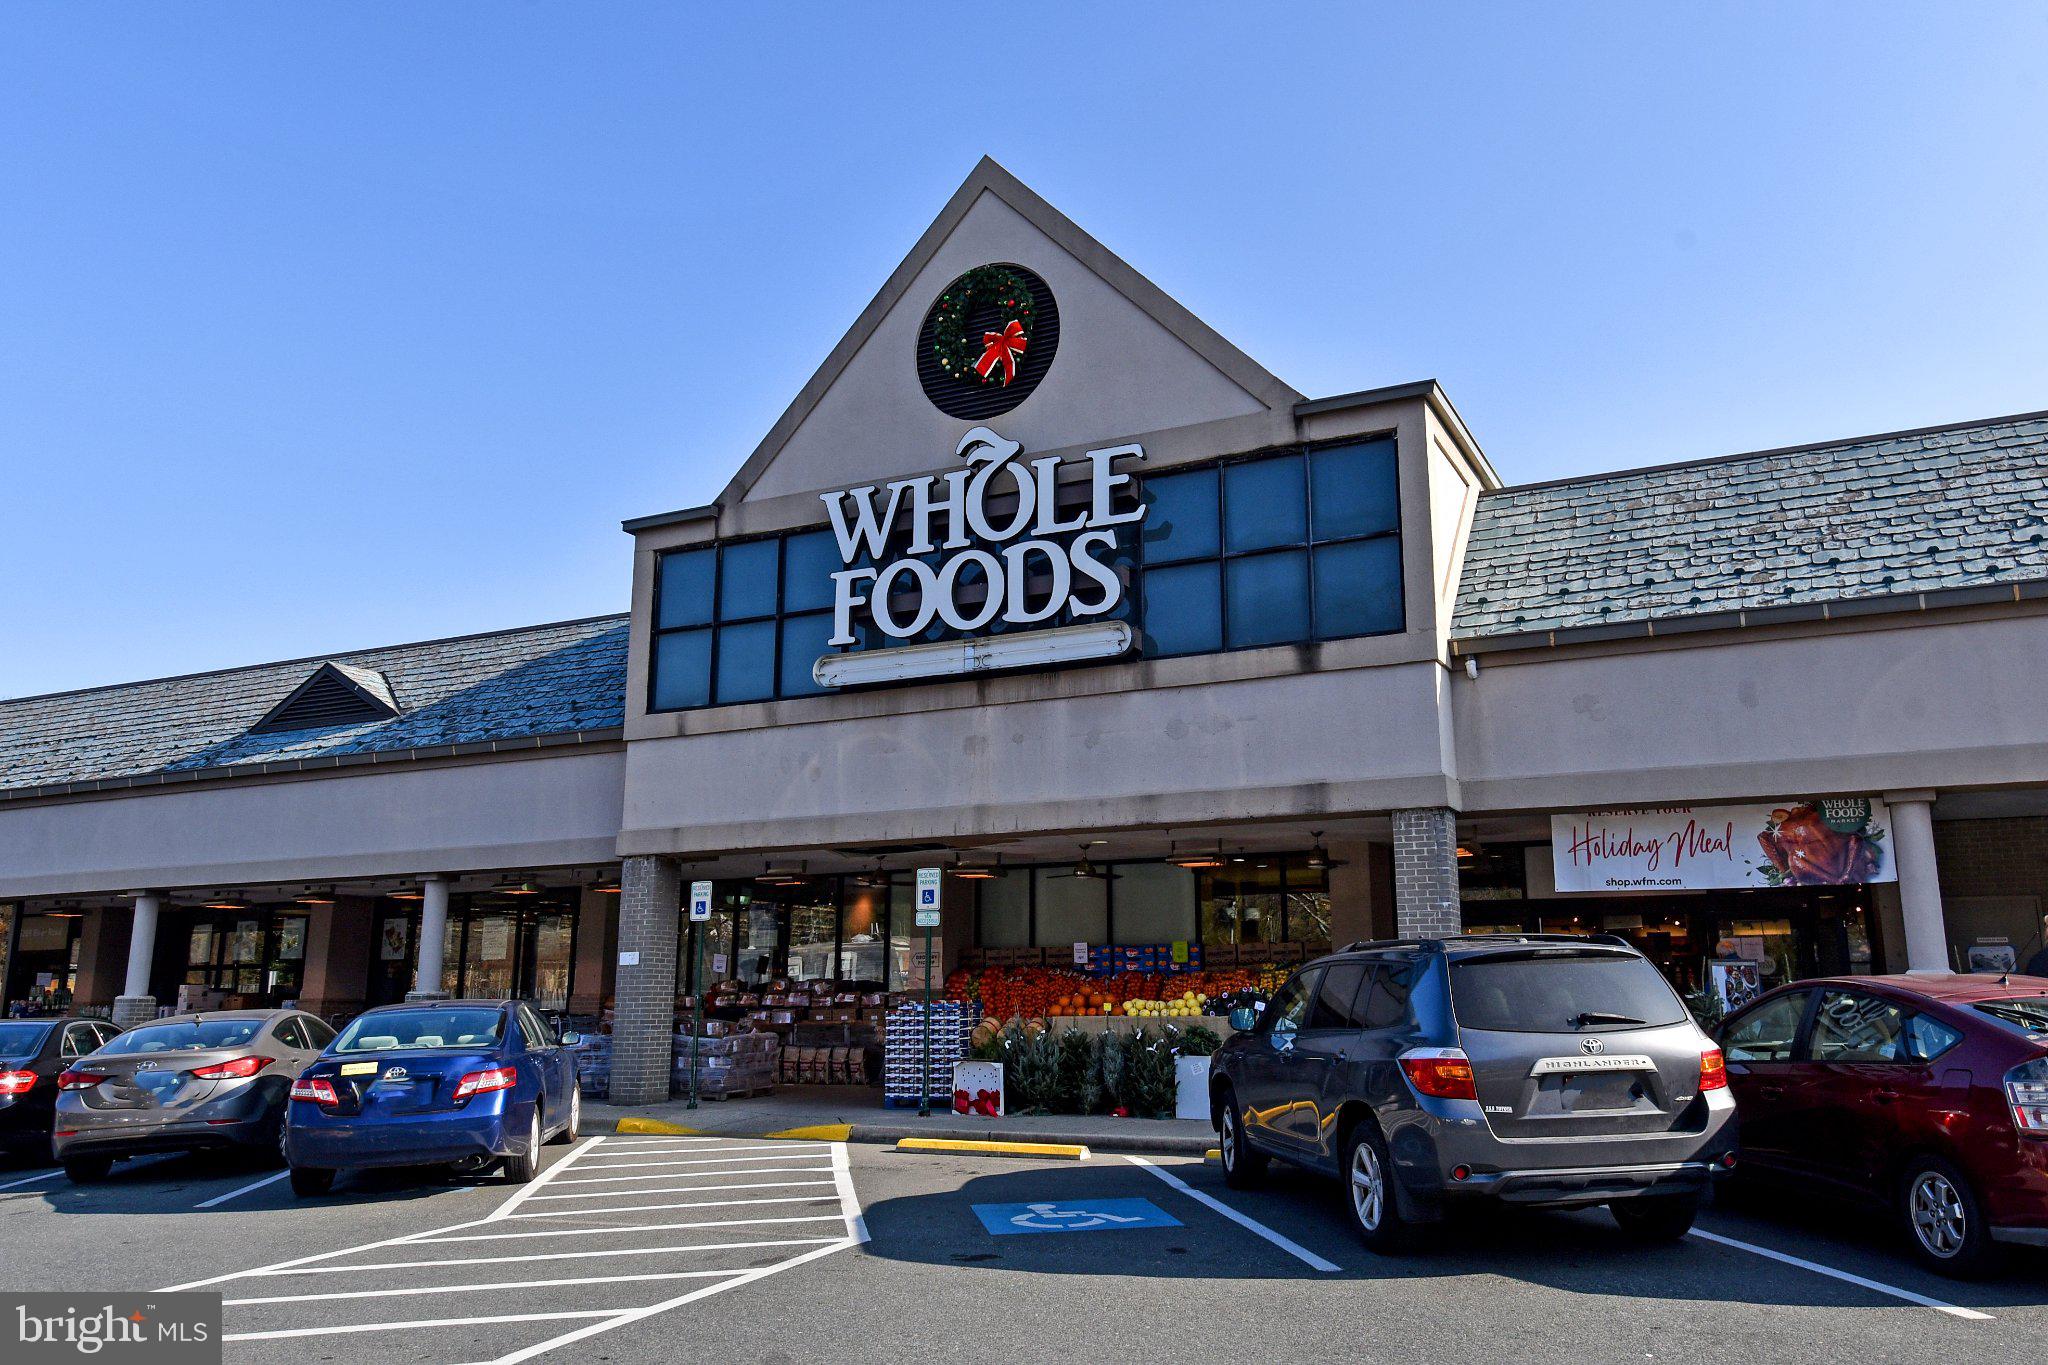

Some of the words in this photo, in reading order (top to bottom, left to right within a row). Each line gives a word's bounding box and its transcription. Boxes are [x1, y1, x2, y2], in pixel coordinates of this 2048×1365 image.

[819, 427, 1148, 564] WHOLE
[828, 529, 1122, 646] FOODS
[1822, 799, 1866, 809] WHOLE
[1825, 807, 1865, 818] FOODS
[1567, 821, 1664, 872] Holiday
[1666, 819, 1733, 868] Meal
[1605, 876, 1682, 888] shop.wfm.com
[1545, 1059, 1640, 1069] HIGHLANDER
